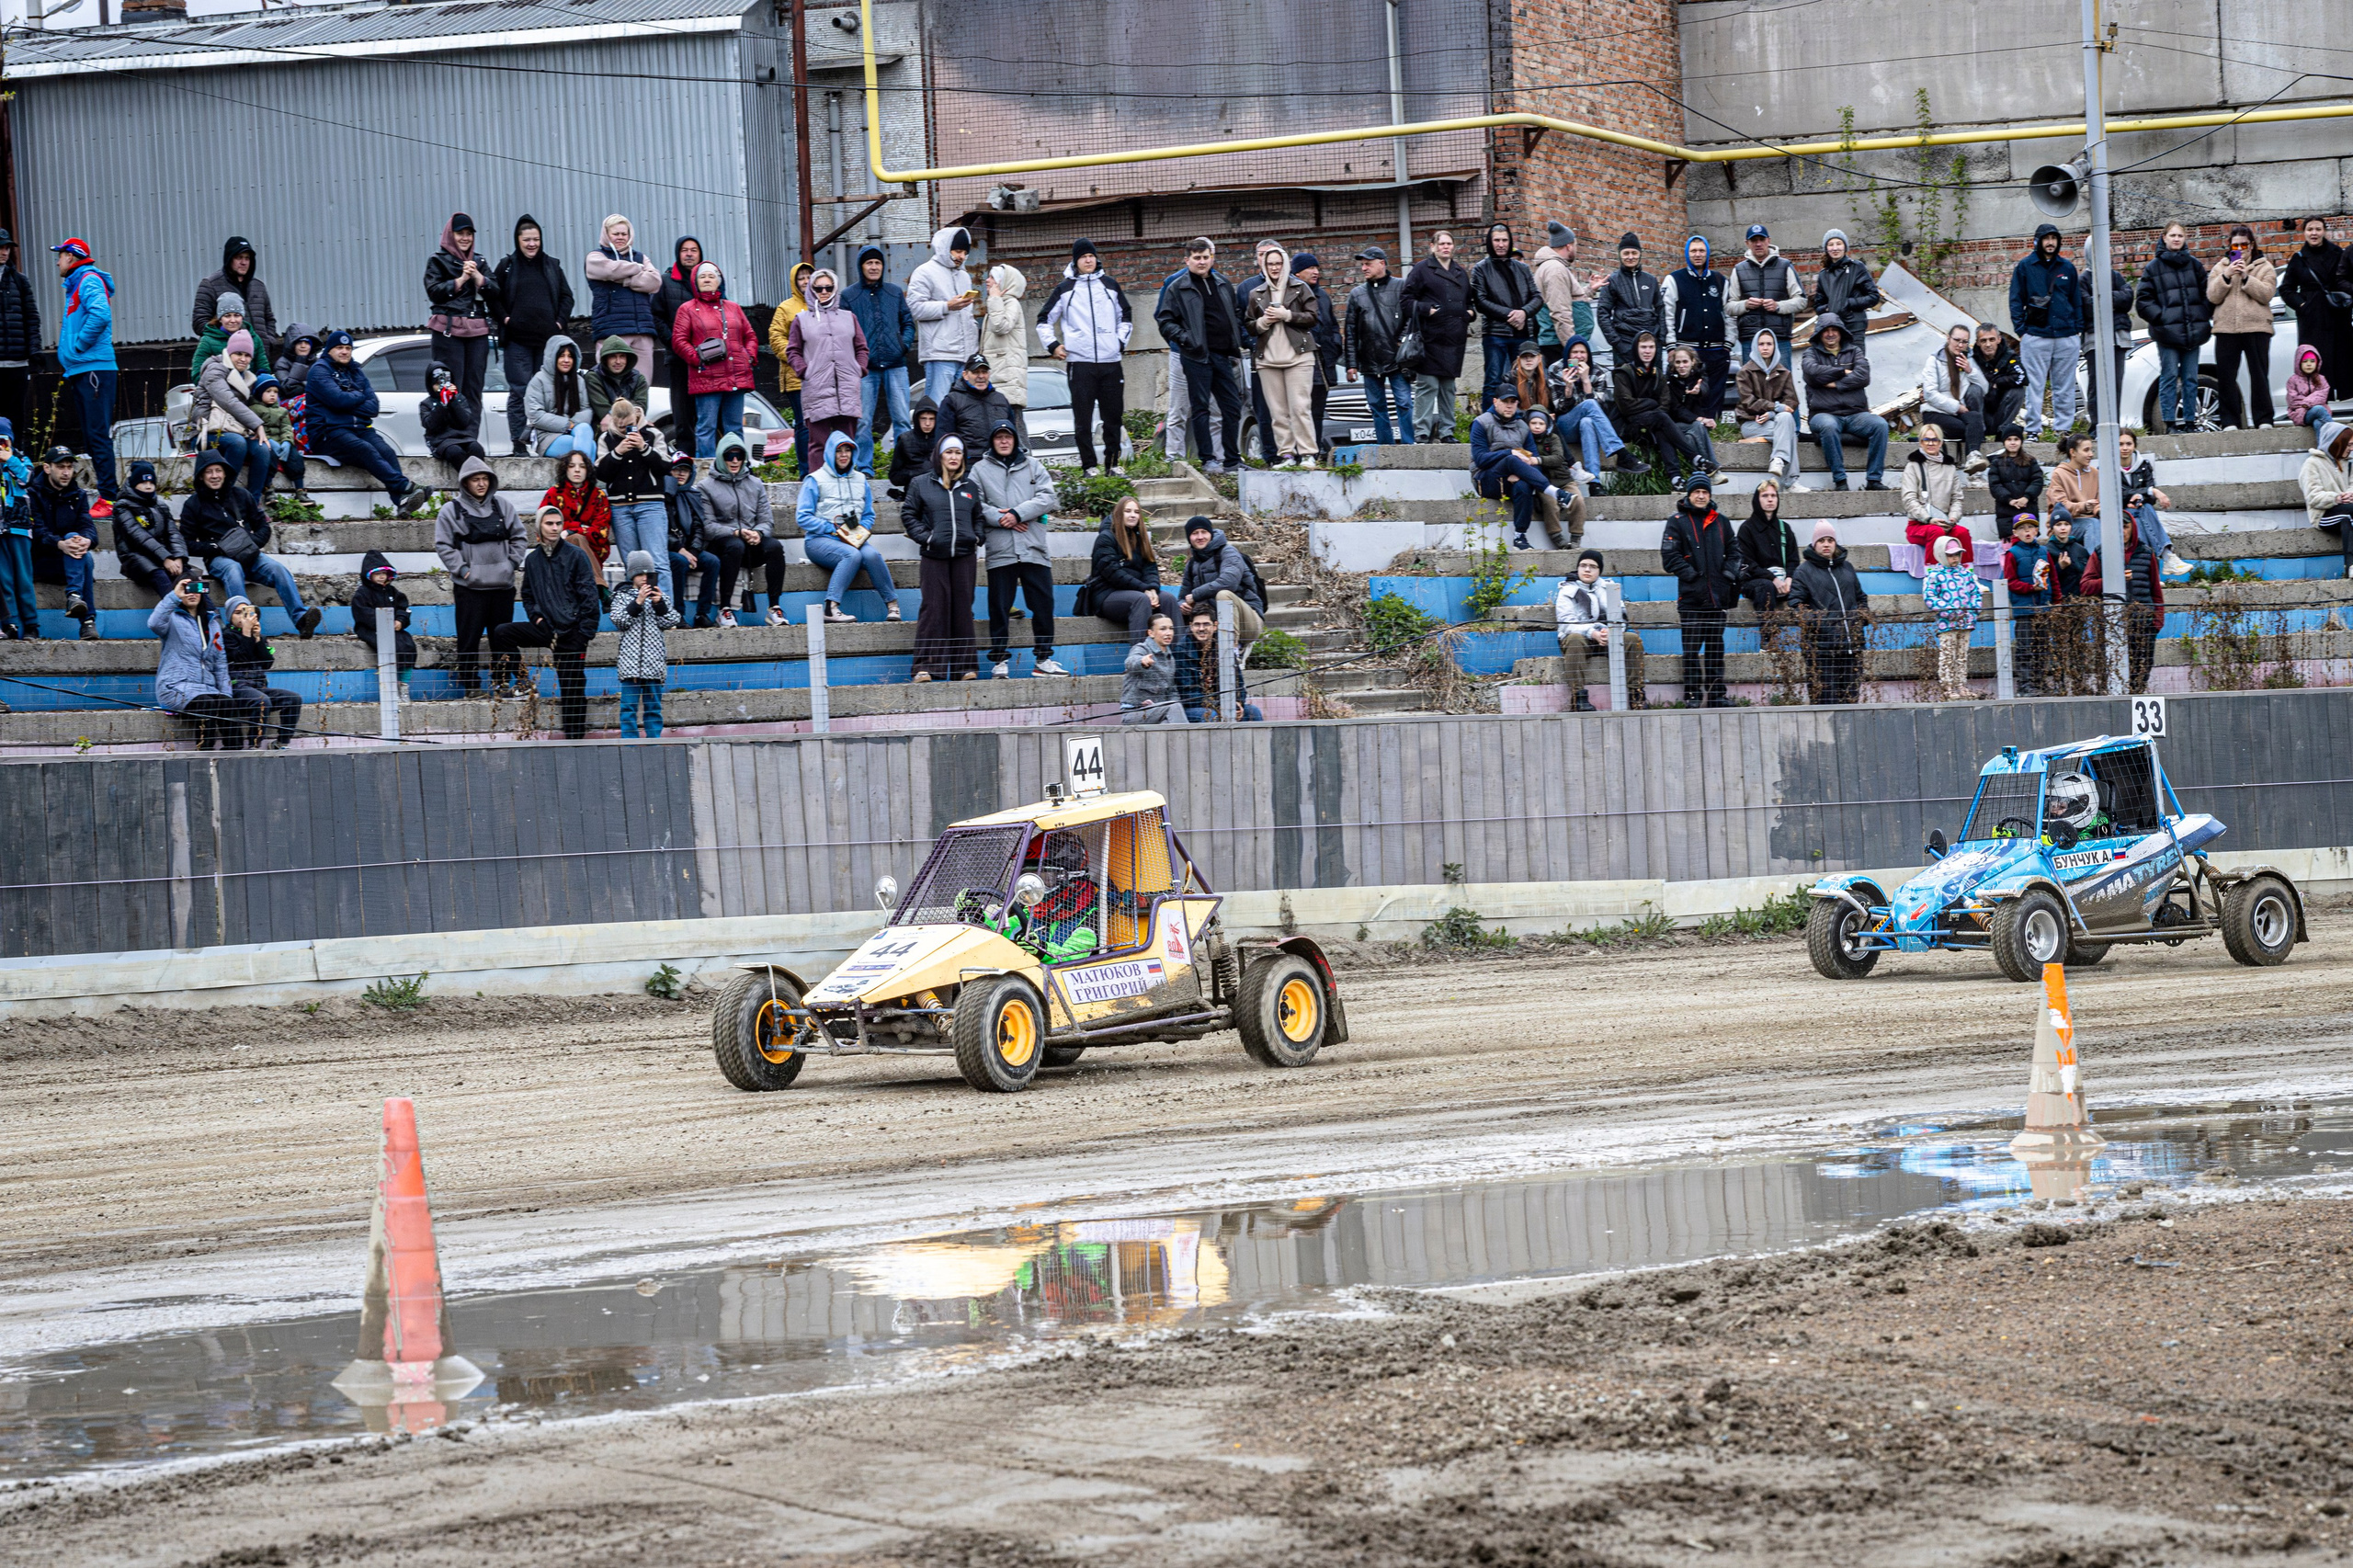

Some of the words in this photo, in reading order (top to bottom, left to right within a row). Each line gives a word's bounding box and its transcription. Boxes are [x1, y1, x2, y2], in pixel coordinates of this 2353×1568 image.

[2135, 700, 2163, 733] 33
[1074, 746, 1103, 781] 44
[2053, 851, 2099, 869] БУНЧУК
[870, 941, 918, 958] 44
[1070, 963, 1142, 985] МАТЮКОВ
[1074, 977, 1148, 1002] ГРИГОРИЙ
